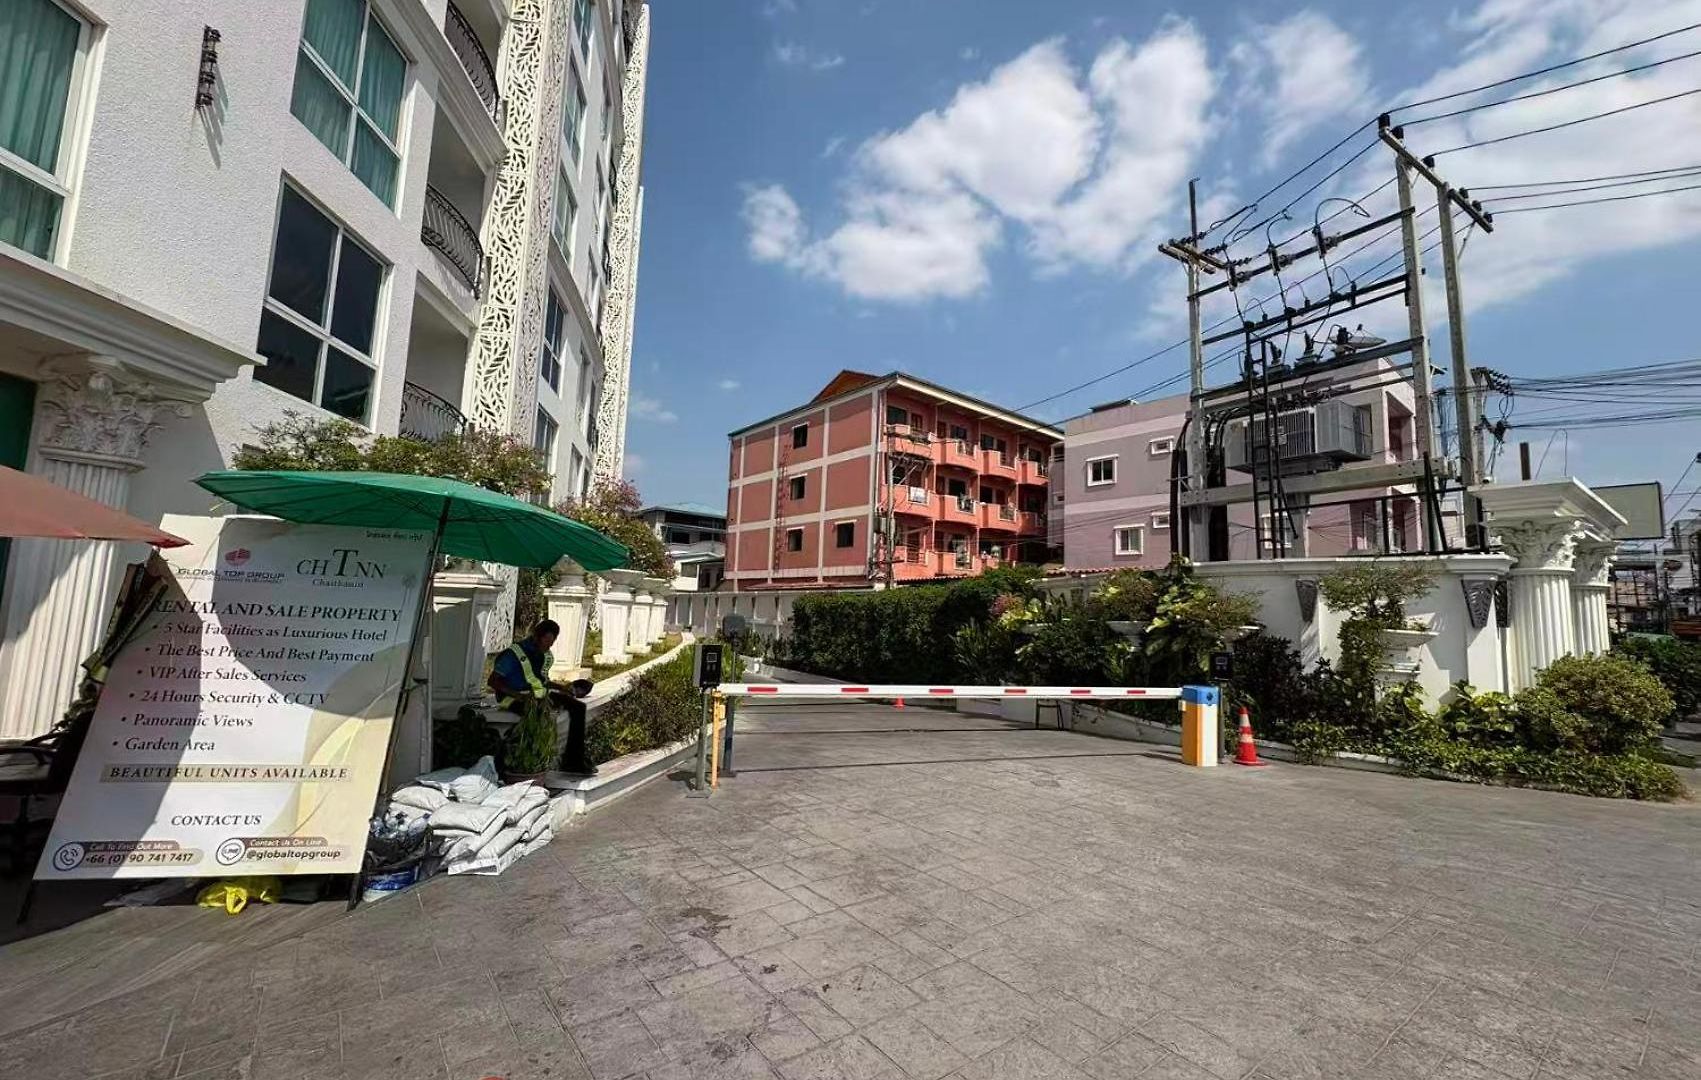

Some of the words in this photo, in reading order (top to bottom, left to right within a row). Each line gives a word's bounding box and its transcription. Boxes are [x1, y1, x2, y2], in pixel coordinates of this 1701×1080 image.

[178, 568, 219, 576] GLOBAL
[223, 570, 245, 578] TOP
[246, 571, 285, 580] GROUP
[221, 602, 263, 616] AND
[265, 604, 309, 618] SALE
[311, 606, 401, 622] PROPERTY
[164, 622, 172, 634] 5
[176, 622, 204, 635] Star
[205, 623, 263, 636] Facilities
[265, 629, 280, 637] as
[283, 627, 348, 640] Luxurious
[351, 629, 388, 641] Hotel
[158, 644, 184, 656] The
[186, 645, 215, 657] Best
[218, 645, 253, 659] Price
[256, 648, 285, 660] And
[287, 649, 316, 661] Best
[319, 649, 375, 664] Payment
[150, 666, 176, 679] VIP
[177, 667, 212, 680] After
[214, 668, 249, 681] Sales
[250, 669, 308, 682] Services
[141, 690, 159, 702] 24
[161, 690, 204, 703] Hours
[207, 690, 264, 708] Security
[267, 693, 280, 704] &
[283, 692, 331, 706] CCTV
[133, 713, 209, 727] Panoramic
[213, 714, 254, 727] Views
[124, 737, 179, 751] Garden
[181, 739, 215, 751] Area
[110, 767, 203, 778] BEAUTIFUL
[209, 767, 259, 778] UNITS
[262, 767, 348, 779] AVAILABLE
[171, 815, 243, 827] CONTACT
[244, 815, 262, 826] US
[85, 854, 105, 863] +66
[107, 853, 126, 865] (0)
[128, 854, 145, 862] 90
[147, 853, 166, 862] 741
[168, 853, 194, 862] 7417
[246, 850, 341, 860] @globaltopgroup
